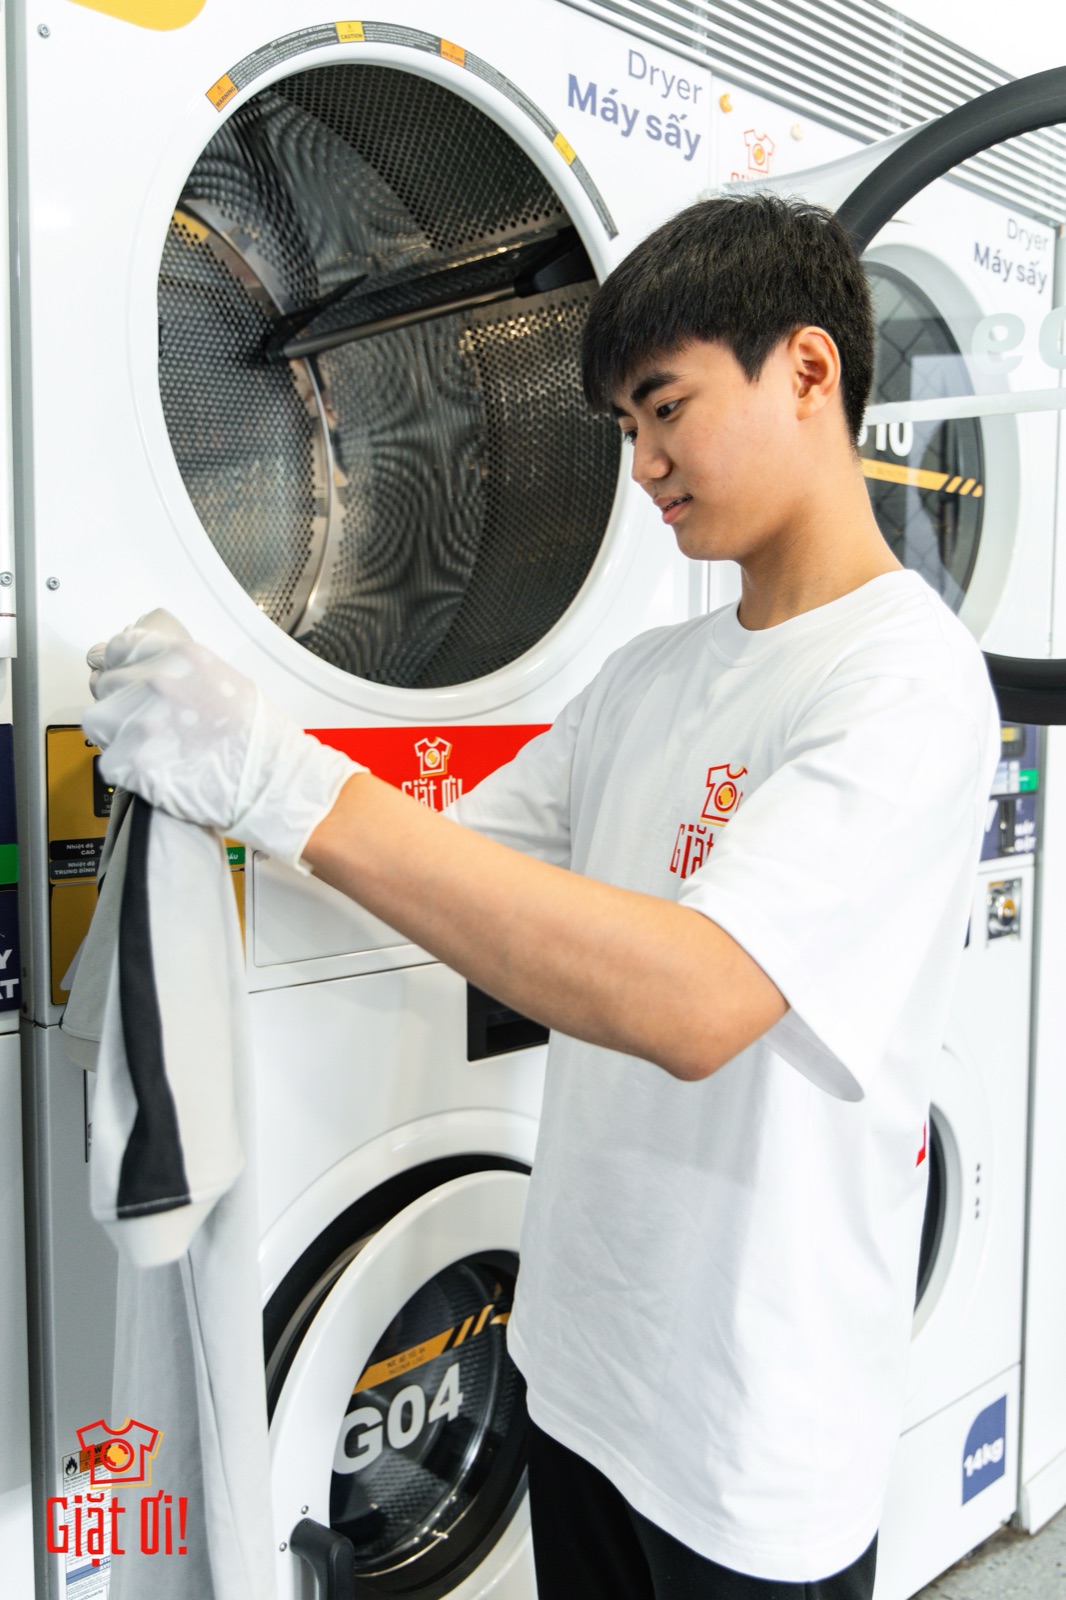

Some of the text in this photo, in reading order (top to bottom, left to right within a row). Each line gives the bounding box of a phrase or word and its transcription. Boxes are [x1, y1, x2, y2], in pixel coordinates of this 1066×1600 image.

[215, 86, 236, 108] WARNING
[628, 49, 702, 104] Dryer
[568, 73, 639, 138] Máy
[645, 113, 702, 162] sấy
[1007, 218, 1049, 252] Dryer
[973, 242, 1048, 295] Máy sấy
[332, 1363, 464, 1475] G04
[963, 1437, 1004, 1478] 14kg
